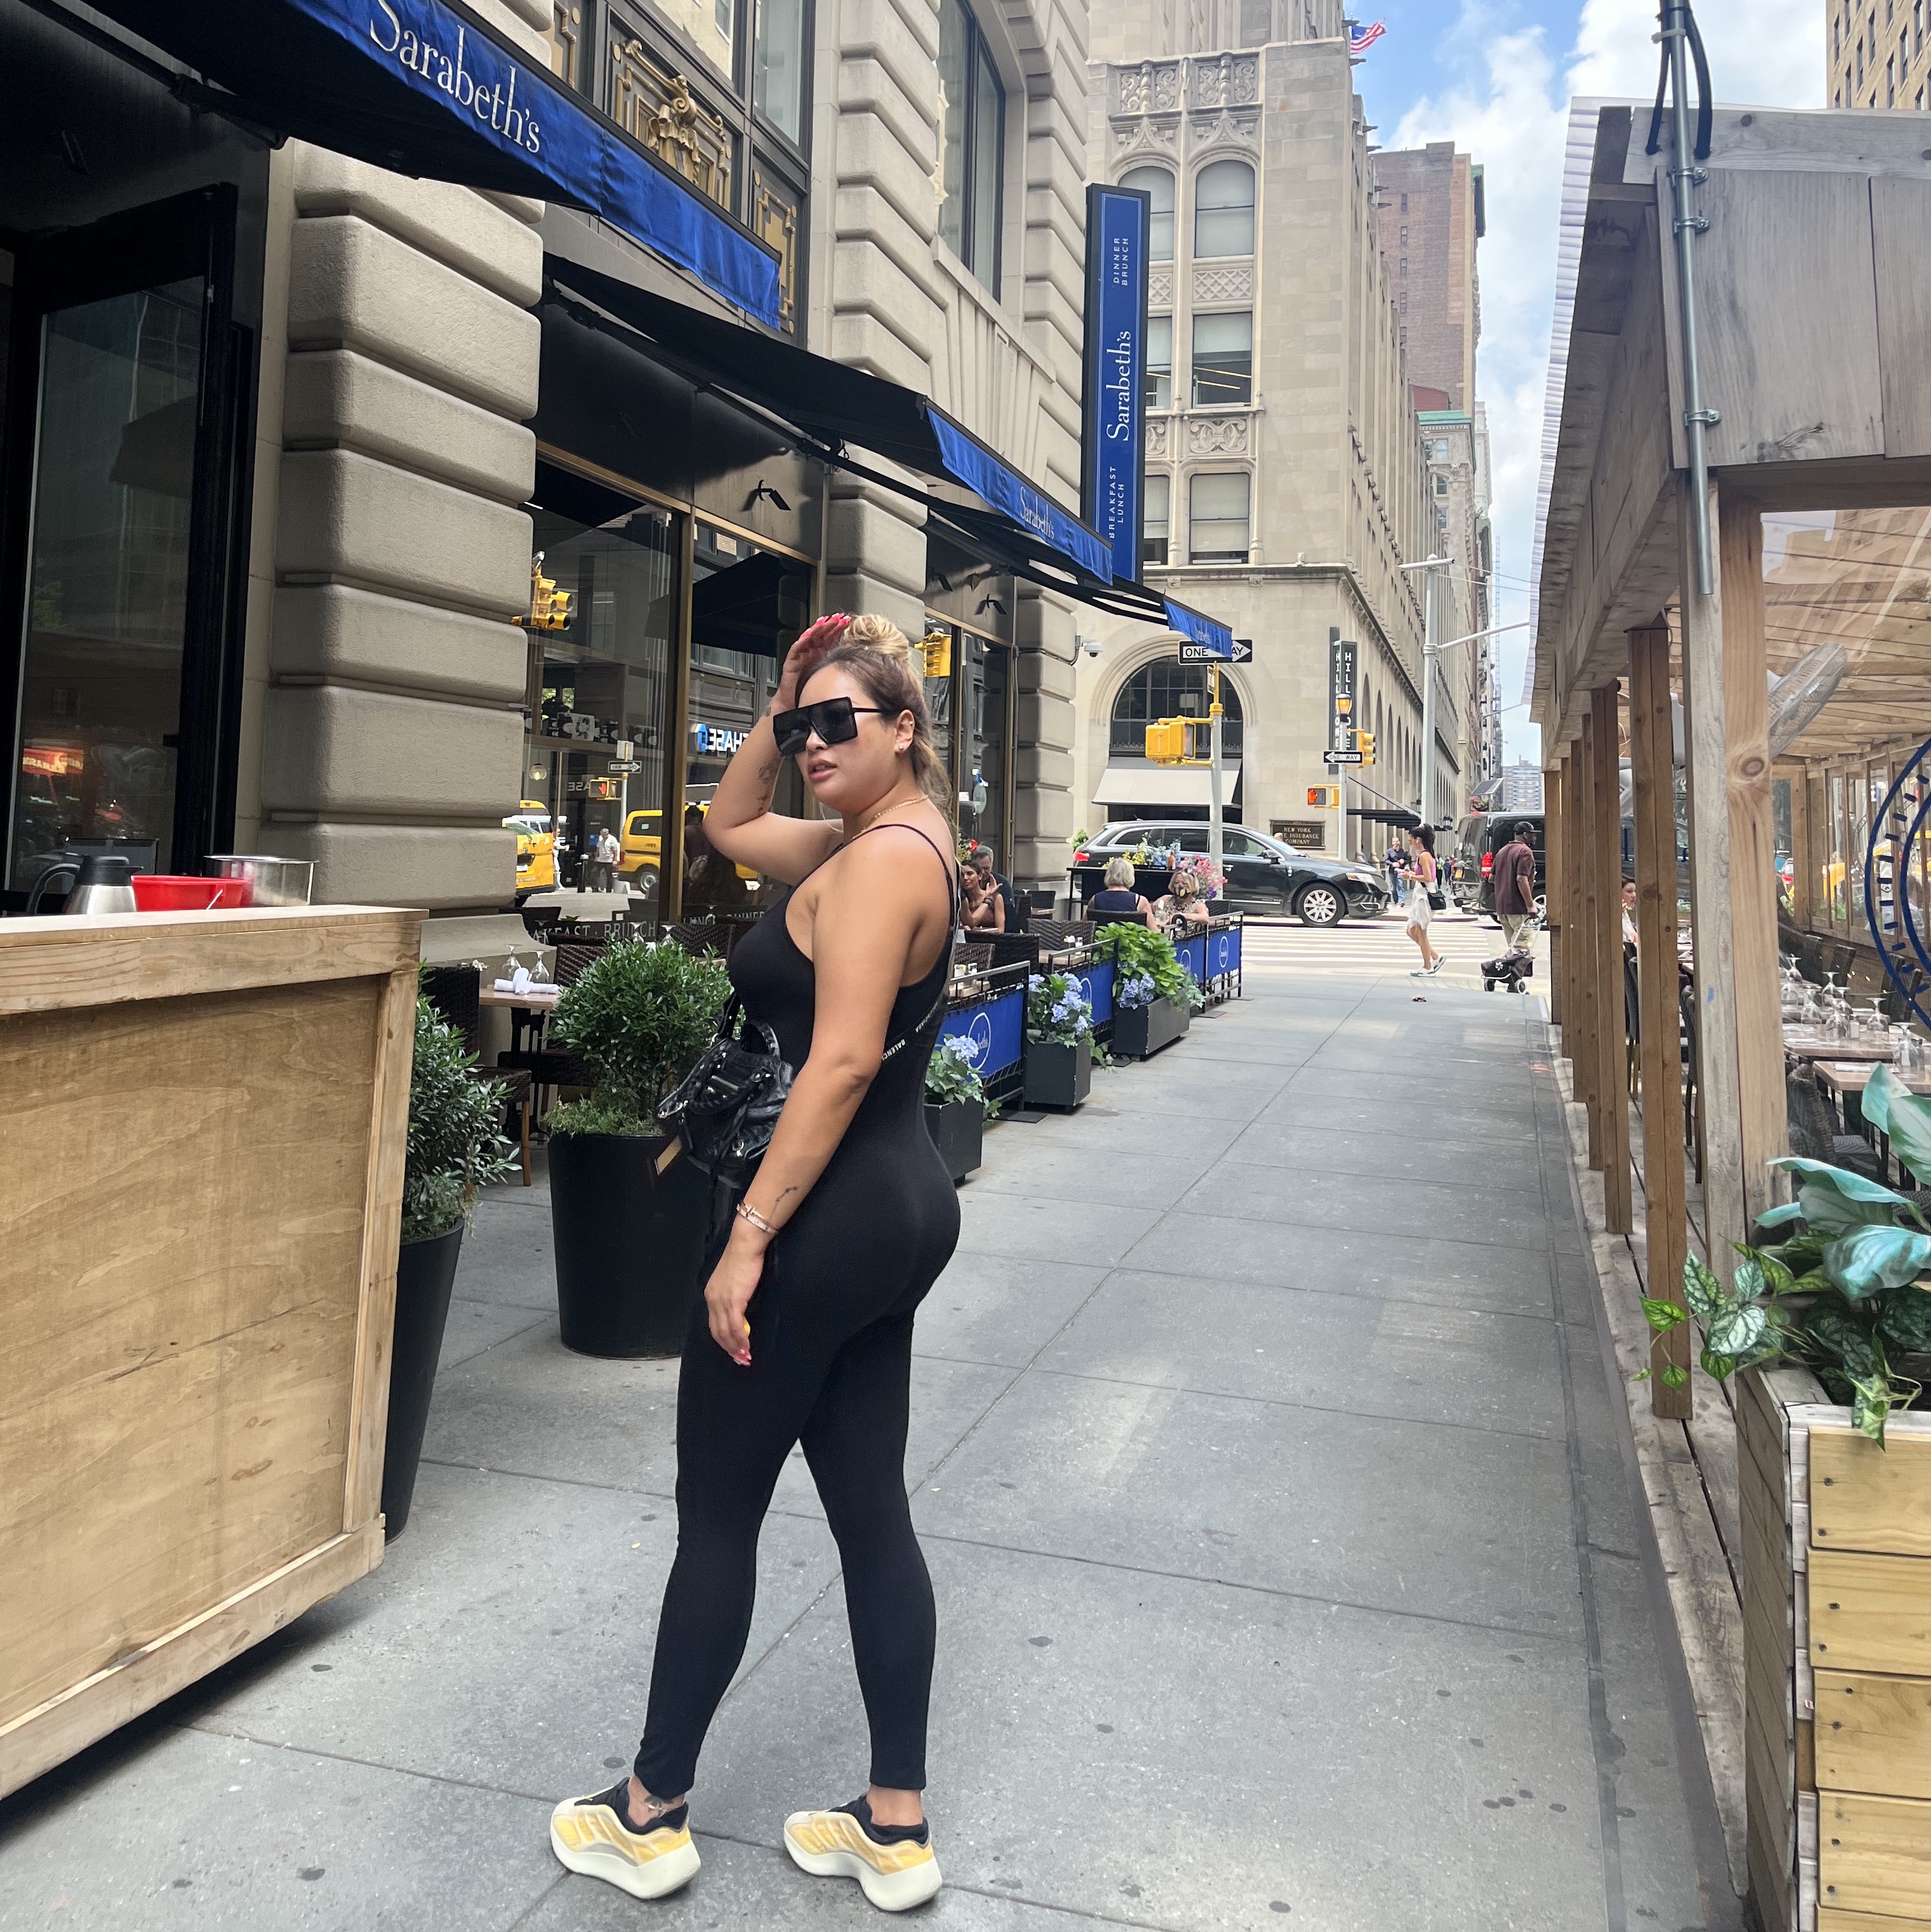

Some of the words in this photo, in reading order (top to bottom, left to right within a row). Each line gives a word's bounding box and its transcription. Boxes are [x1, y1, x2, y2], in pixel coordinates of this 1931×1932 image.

[370, 0, 540, 153] Sarabeth's
[1105, 330, 1132, 442] Sarabeth's
[1020, 486, 1055, 540] Sarabeth's
[1185, 648, 1209, 657] ONE
[1231, 646, 1243, 656] AY
